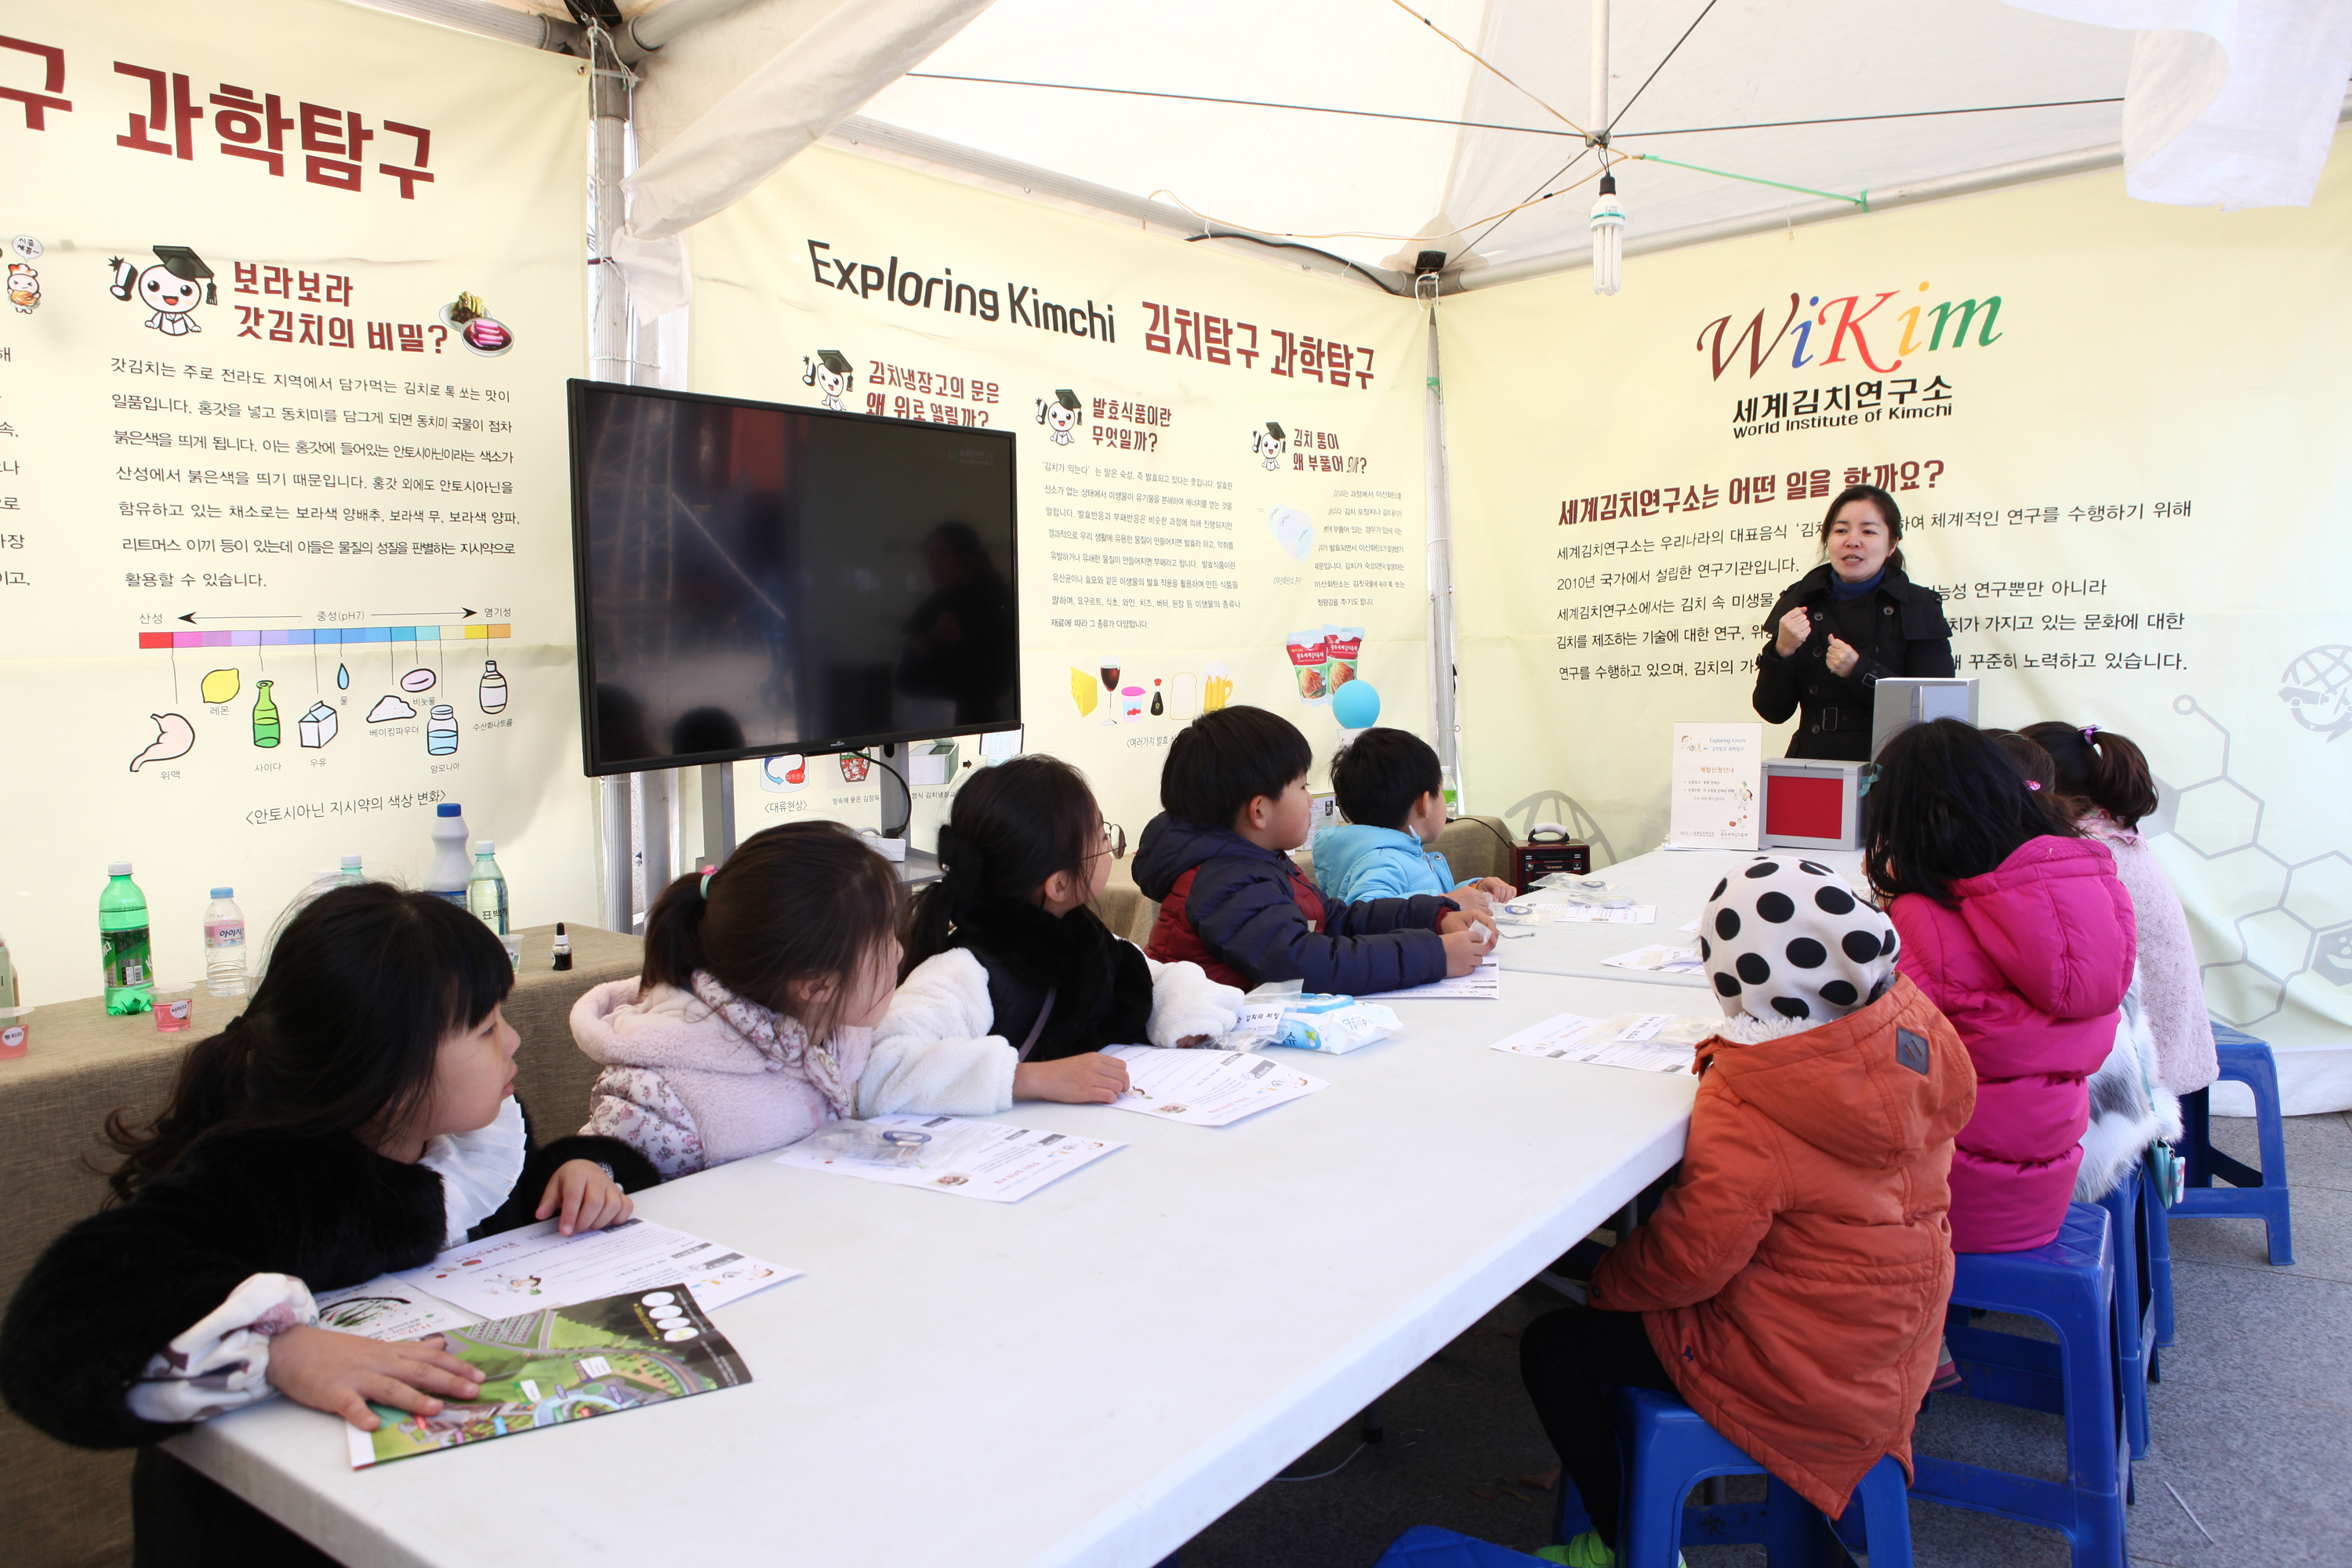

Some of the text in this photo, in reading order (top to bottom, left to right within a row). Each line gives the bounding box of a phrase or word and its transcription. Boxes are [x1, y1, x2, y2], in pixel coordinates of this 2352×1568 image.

[114, 60, 434, 200] 과학탐구
[234, 261, 354, 306] 보라보라
[808, 239, 1374, 390] Exploring Kimchi 김치탐구 과학탐구
[234, 305, 451, 354] 갓김치의 비밀?
[1697, 281, 2003, 383] WiKim
[111, 358, 509, 403] 갓김치는 주로 전라도 지역에서 담가먹는 김치로 톡 쏘는 맛이
[869, 361, 999, 404] 김치냉장고의 문은
[866, 392, 989, 427] 왜 위로 열릴까?
[1733, 375, 1952, 423] 세계김치연구소
[112, 394, 512, 433] 일품입니다. 홍갓을 넣고 동치미를 담그게 되면 동치미 국물이 점차
[1093, 397, 1171, 427] 발효식품이란
[1733, 403, 1952, 439] World Institute of Kimchi
[1092, 426, 1157, 452] 무엇일까?
[1294, 429, 1339, 450] 김치 통이
[1293, 453, 1304, 471] 왜
[1308, 455, 1343, 472] 부풀어
[116, 466, 513, 494] 산성에서 붉은색을 띄기 때문입니다. 홍갓 외에도 안토시아닌을
[1559, 460, 1944, 525] 세계김치연구소는 어떤 일을 할까요?
[119, 502, 519, 524] 함유하고 있는 채소로는 보라색 양배추, 보라색 무, 보라색 양파,
[1931, 500, 2190, 528] 체계적인 연구를 수행하기 위해
[1557, 524, 1787, 560] 세계김치연구소는 우리나라의 대표음식
[125, 573, 267, 587] 활용할 수 있습니다.
[1558, 557, 1798, 590] 2010년 국가에서 설립한 연구기관입니다.
[1975, 579, 2107, 598] 연구뿐만 아니라
[317, 611, 365, 622] 중성(pH7)
[485, 608, 510, 617] 염기성
[1557, 593, 1777, 621] 세계김치연구소에서는 김치 속 미생물
[139, 613, 162, 624] 산성
[1985, 613, 2185, 632] 가지고 있는 문화에 대한
[1557, 626, 1744, 649] 김치를 제조하는 기술에 대한 연구,
[1559, 660, 1733, 680] 연구를 수행하고 있으며, 김치의
[1969, 652, 2187, 670] 꾸준히 노력하고 있습니다.
[210, 706, 229, 716] 레몬
[339, 696, 348, 706] 물
[413, 698, 437, 706] 비눗물
[369, 726, 419, 738] 베이킹파우더
[473, 719, 513, 731] 수산화나트륨
[1127, 735, 1167, 748] <여러가지 발효
[255, 762, 281, 773] 사이다
[310, 758, 327, 768] 우유
[430, 762, 459, 774] 암모니아
[161, 770, 180, 780] 위액
[925, 791, 956, 800] 김치냉장고
[246, 789, 446, 825] <안토시아닌 지시약의 색상 변화>
[764, 800, 807, 813] <대류현상>
[171, 1004, 187, 1014] 사이다
